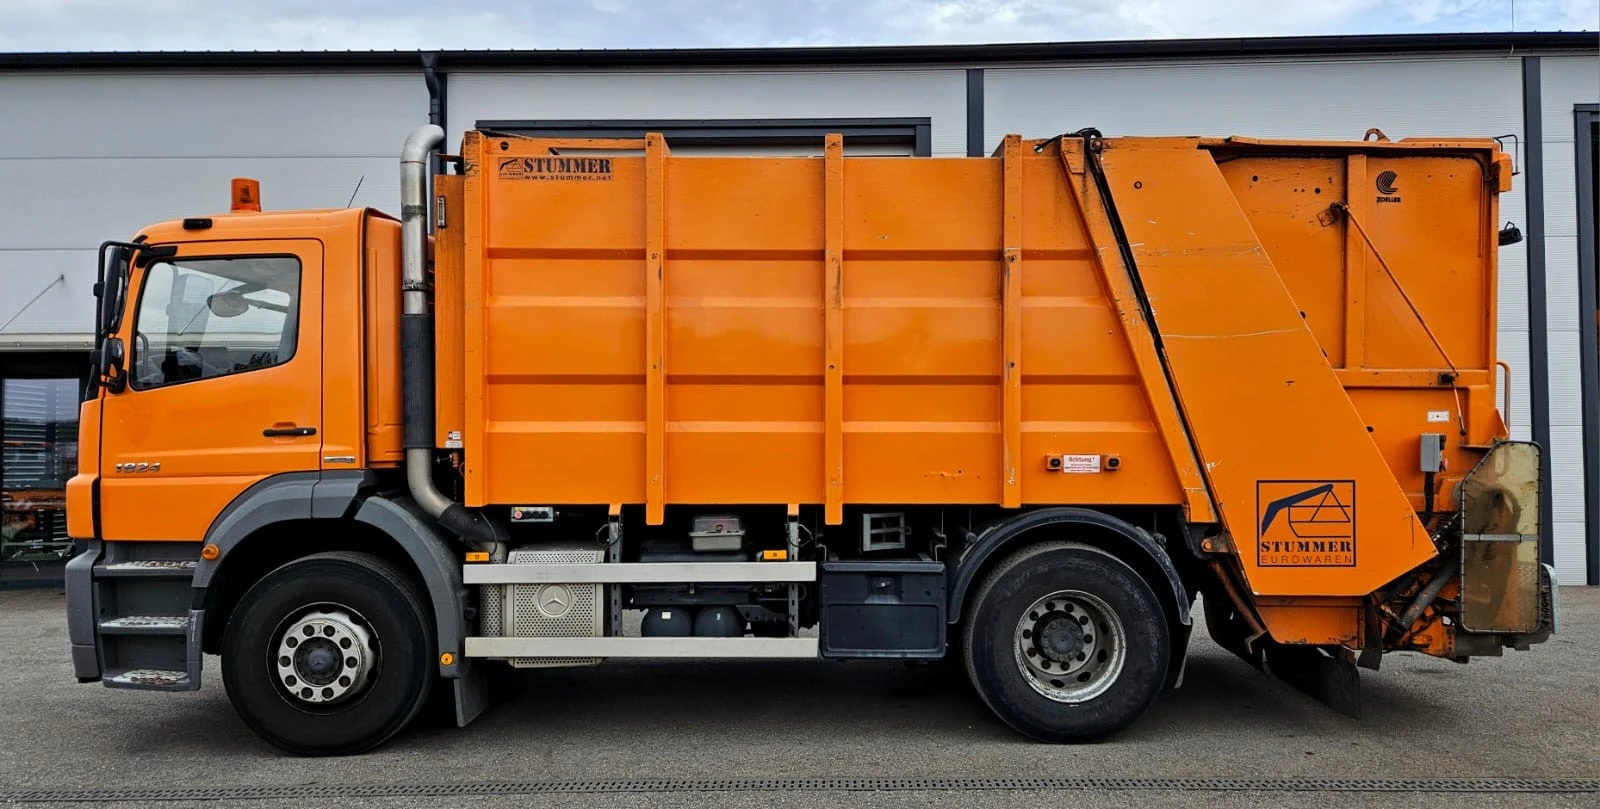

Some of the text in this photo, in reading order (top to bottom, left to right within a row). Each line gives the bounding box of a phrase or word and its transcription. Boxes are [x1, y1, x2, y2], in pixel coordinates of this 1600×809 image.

[523, 158, 611, 173] STUMMER
[1261, 541, 1352, 552] STUMMER
[1261, 555, 1352, 563] EUROWAREN
